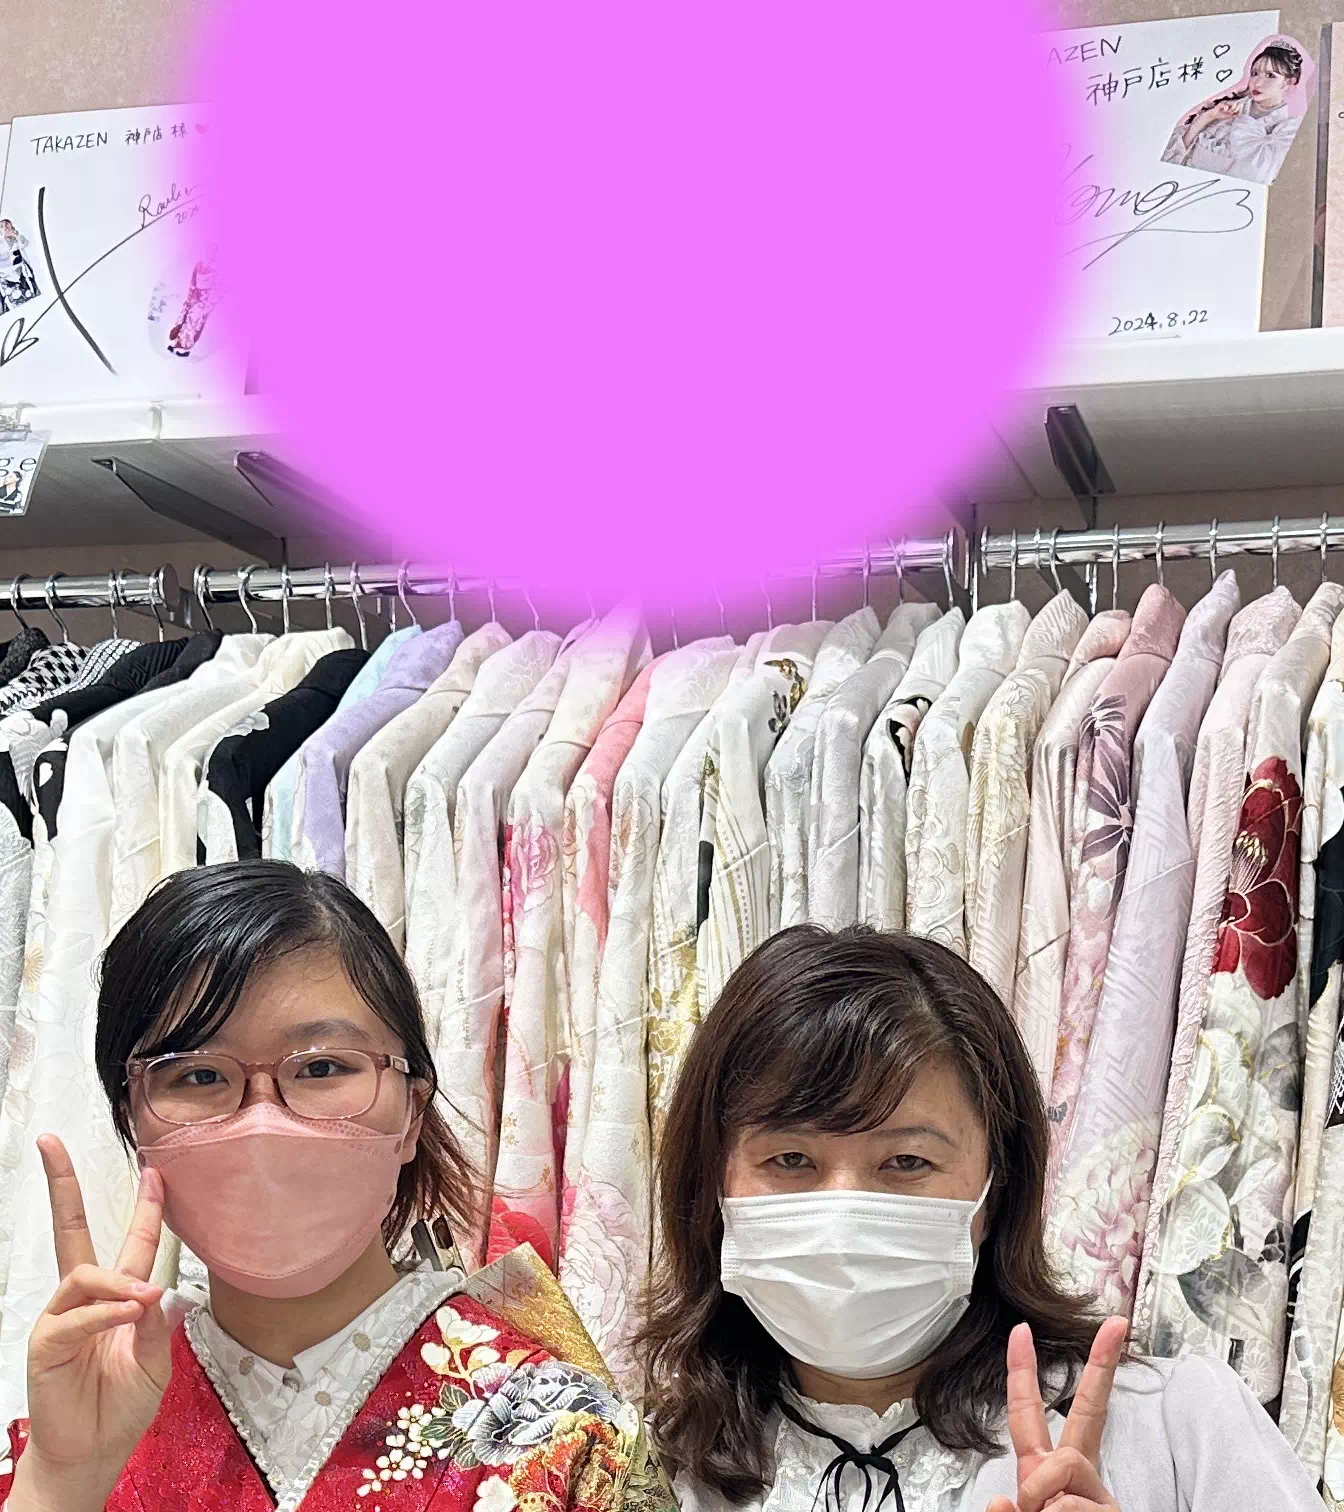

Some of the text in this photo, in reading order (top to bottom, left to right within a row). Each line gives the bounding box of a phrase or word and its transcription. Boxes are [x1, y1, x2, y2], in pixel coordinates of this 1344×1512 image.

[1047, 36, 1122, 69] AZEN
[1086, 56, 1205, 106] 神戸店様
[30, 132, 108, 156] TAKAZEN
